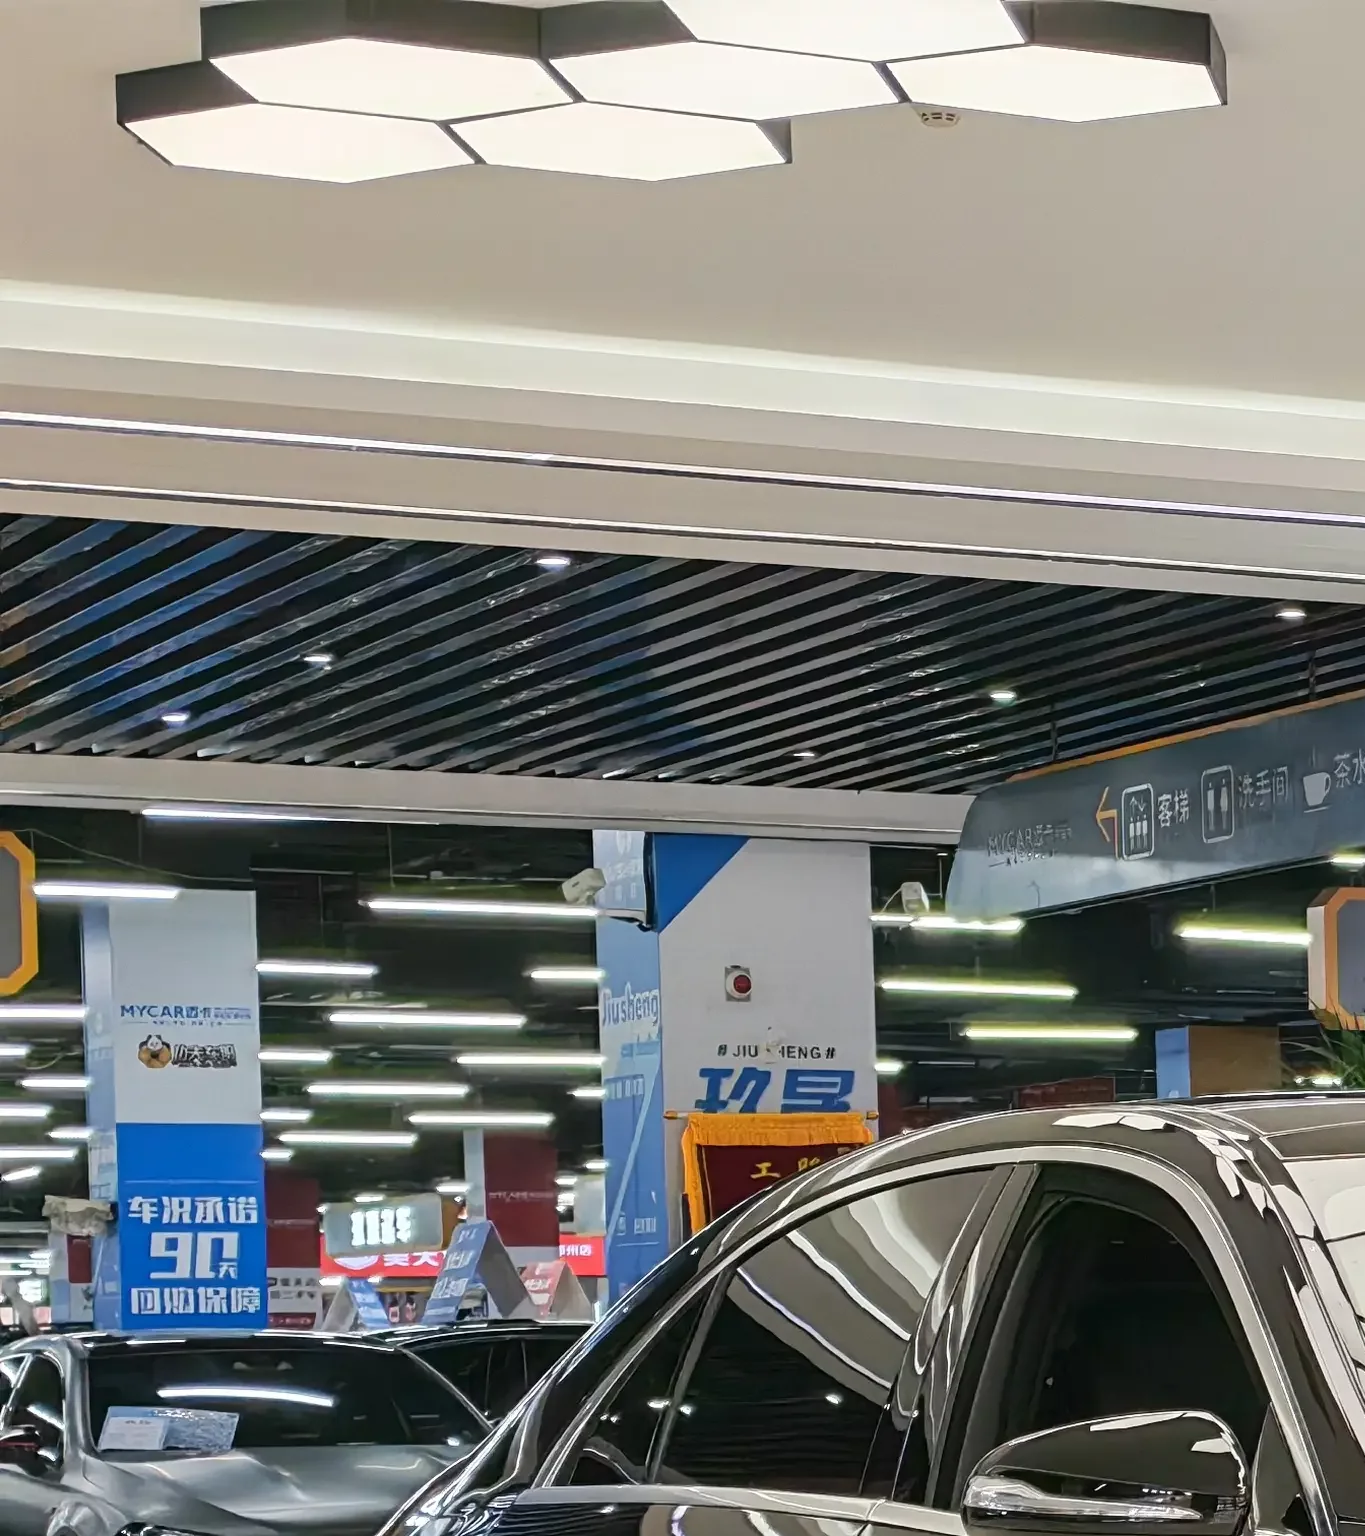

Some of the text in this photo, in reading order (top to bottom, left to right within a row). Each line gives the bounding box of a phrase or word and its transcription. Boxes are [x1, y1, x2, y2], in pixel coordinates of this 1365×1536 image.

[1157, 788, 1190, 828] 客梯
[1237, 766, 1289, 809] 洗手间
[120, 1005, 185, 1018] MYCAR
[732, 1045, 759, 1058] JIU
[765, 1045, 822, 1059] HENG
[127, 1195, 258, 1225] 车况承诺
[130, 1286, 262, 1315] 回购保障
